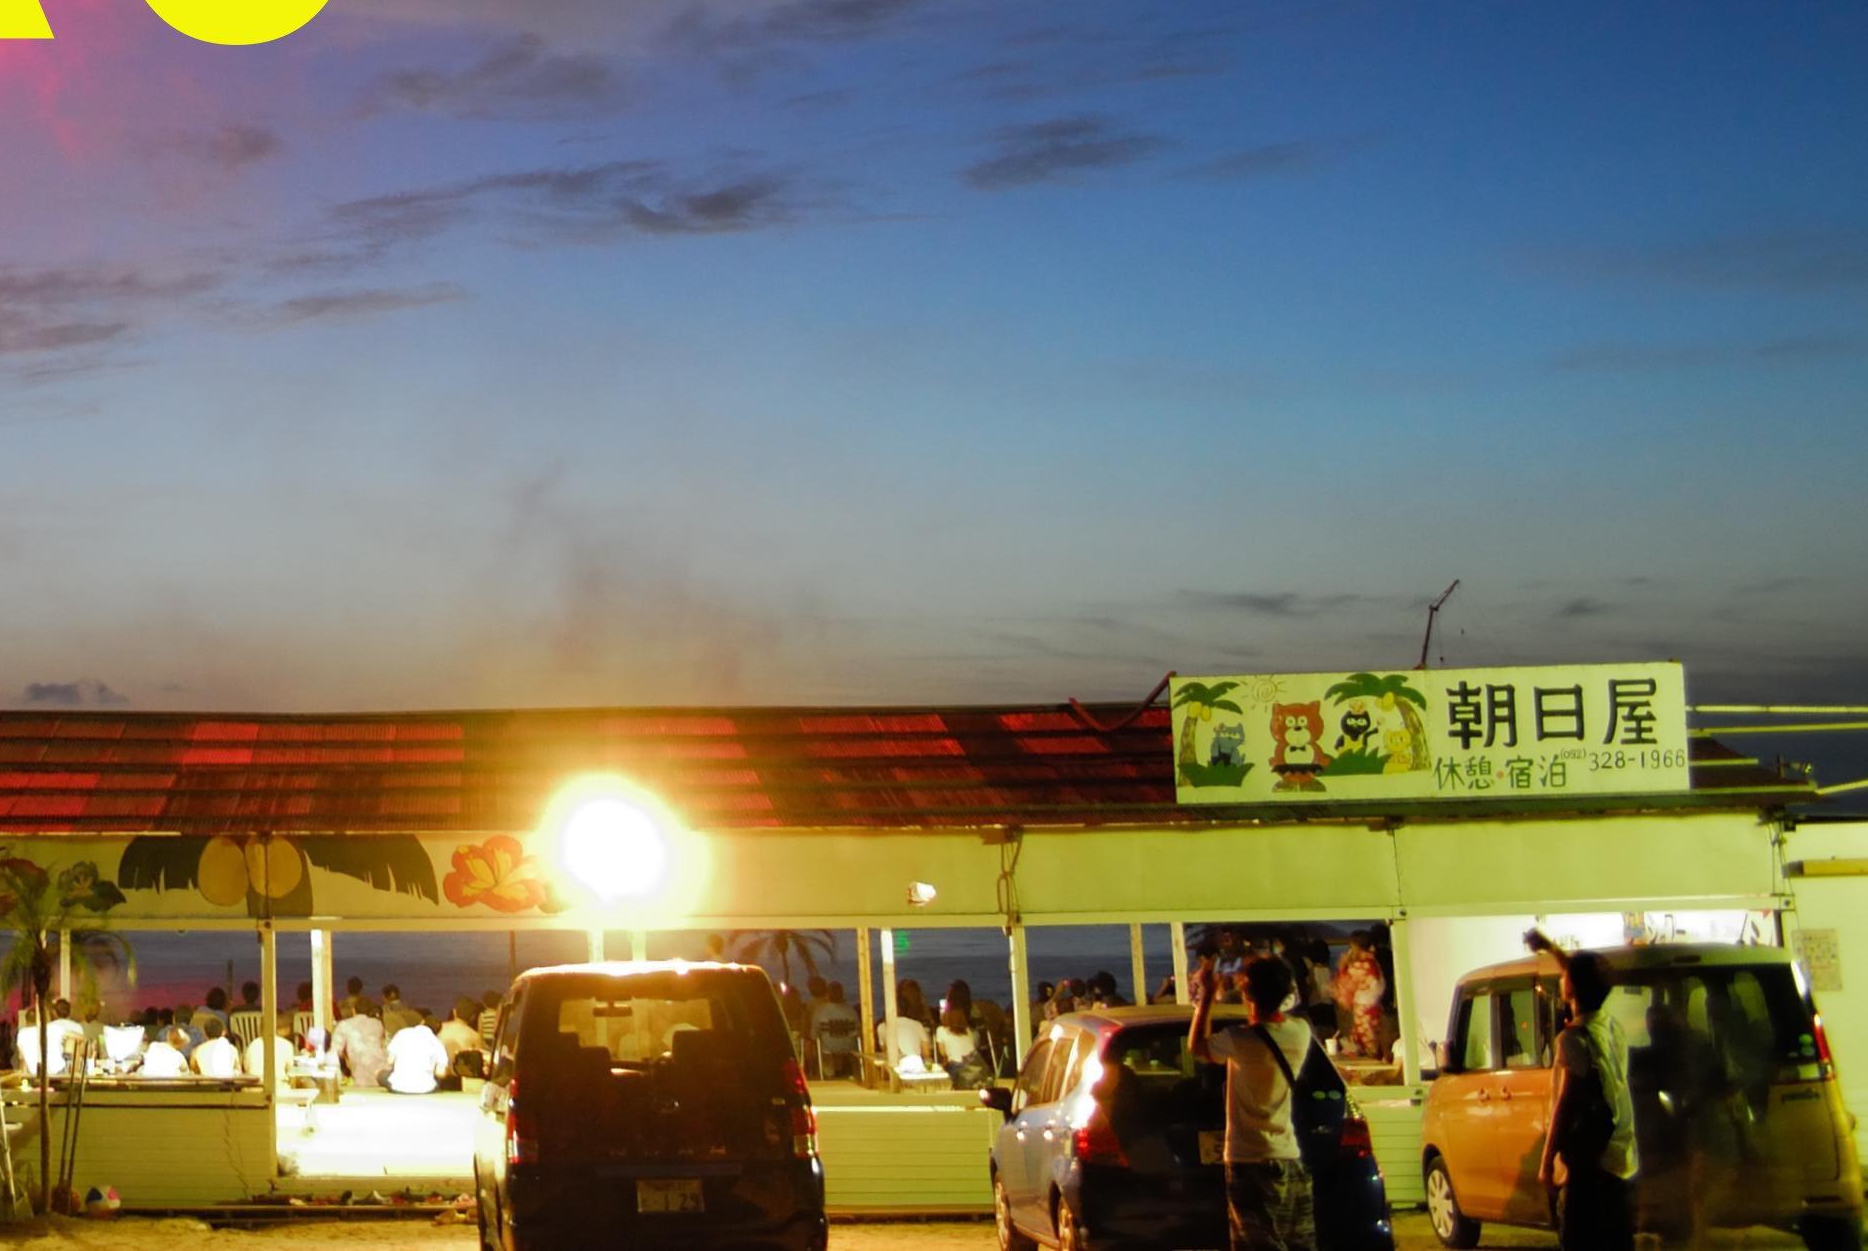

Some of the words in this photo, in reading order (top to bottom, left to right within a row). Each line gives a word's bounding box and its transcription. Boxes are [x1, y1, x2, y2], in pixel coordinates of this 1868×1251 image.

[1446, 678, 1658, 750] 朝日屋
[1589, 749, 1685, 772] 328-1966
